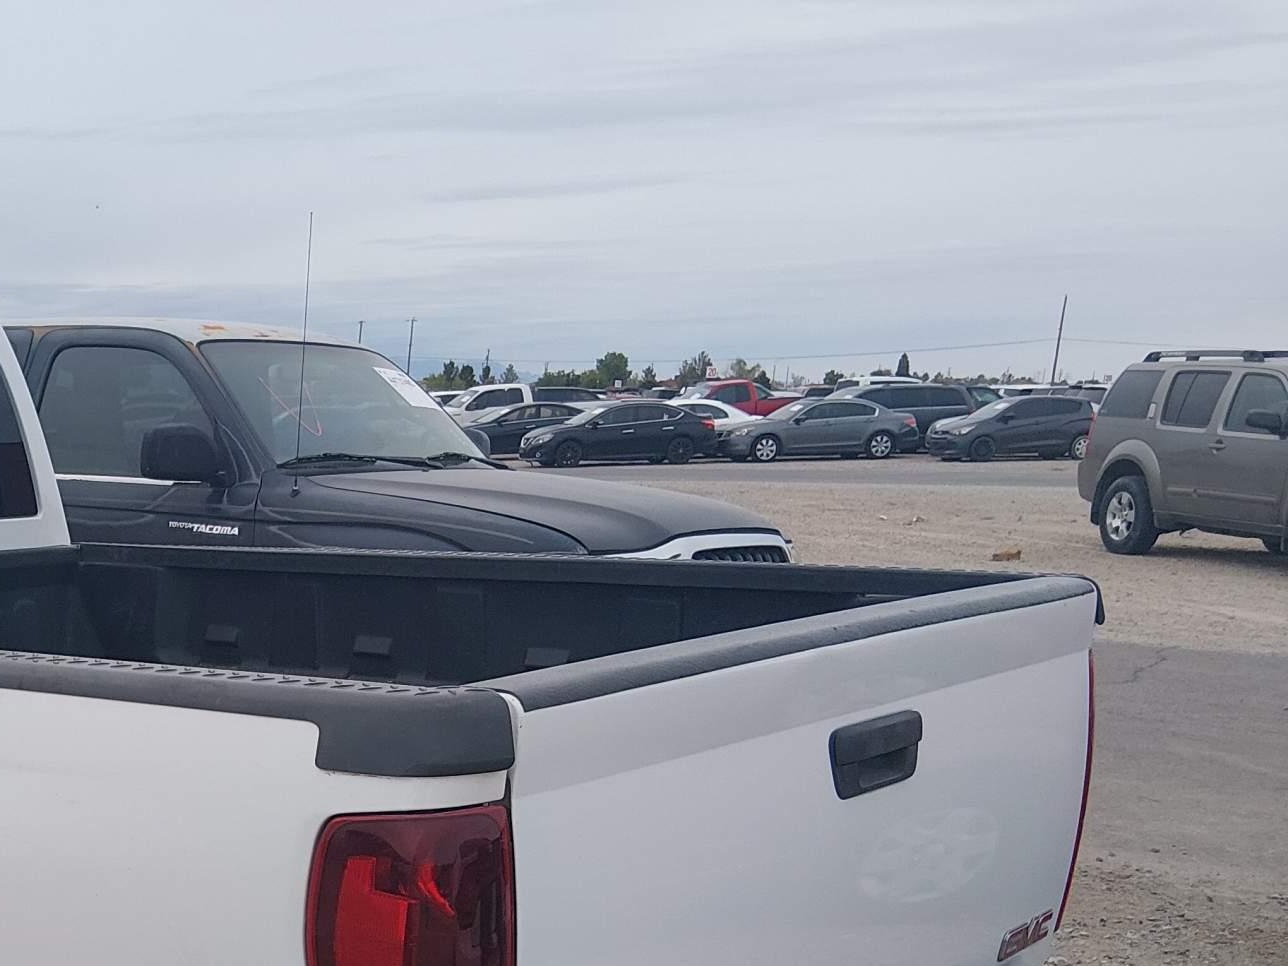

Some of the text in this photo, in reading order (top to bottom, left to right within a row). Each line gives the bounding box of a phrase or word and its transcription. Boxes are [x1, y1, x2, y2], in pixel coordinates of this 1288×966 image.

[168, 521, 239, 536] TOYOTA TACOMA
[997, 908, 1053, 962] GMC
